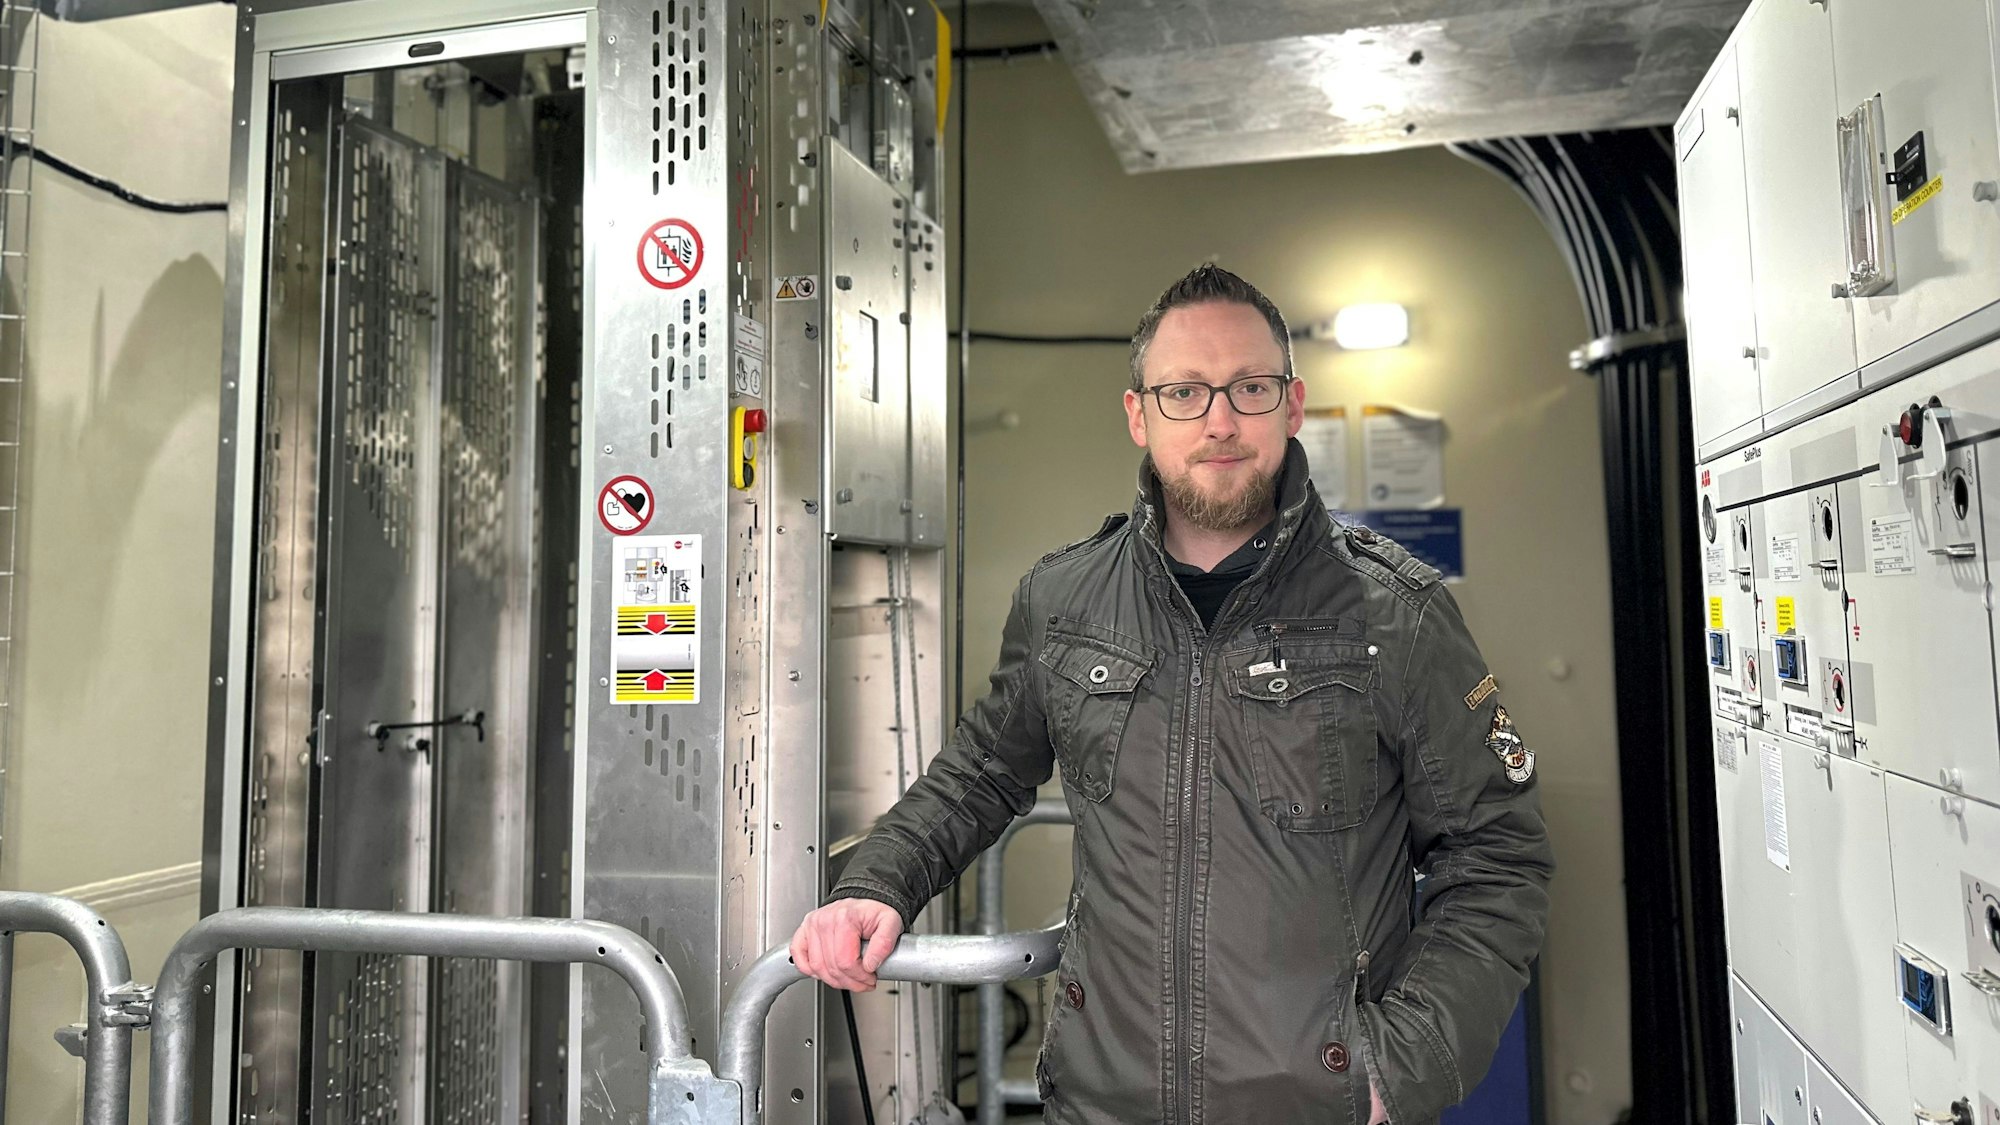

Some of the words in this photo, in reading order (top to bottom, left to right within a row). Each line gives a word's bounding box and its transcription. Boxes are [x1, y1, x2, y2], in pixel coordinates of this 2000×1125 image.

[1899, 196, 1921, 217] OPERATION
[1921, 178, 1942, 200] COUNTER
[1744, 446, 1761, 463] SafePlus
[1701, 469, 1711, 489] ABB
